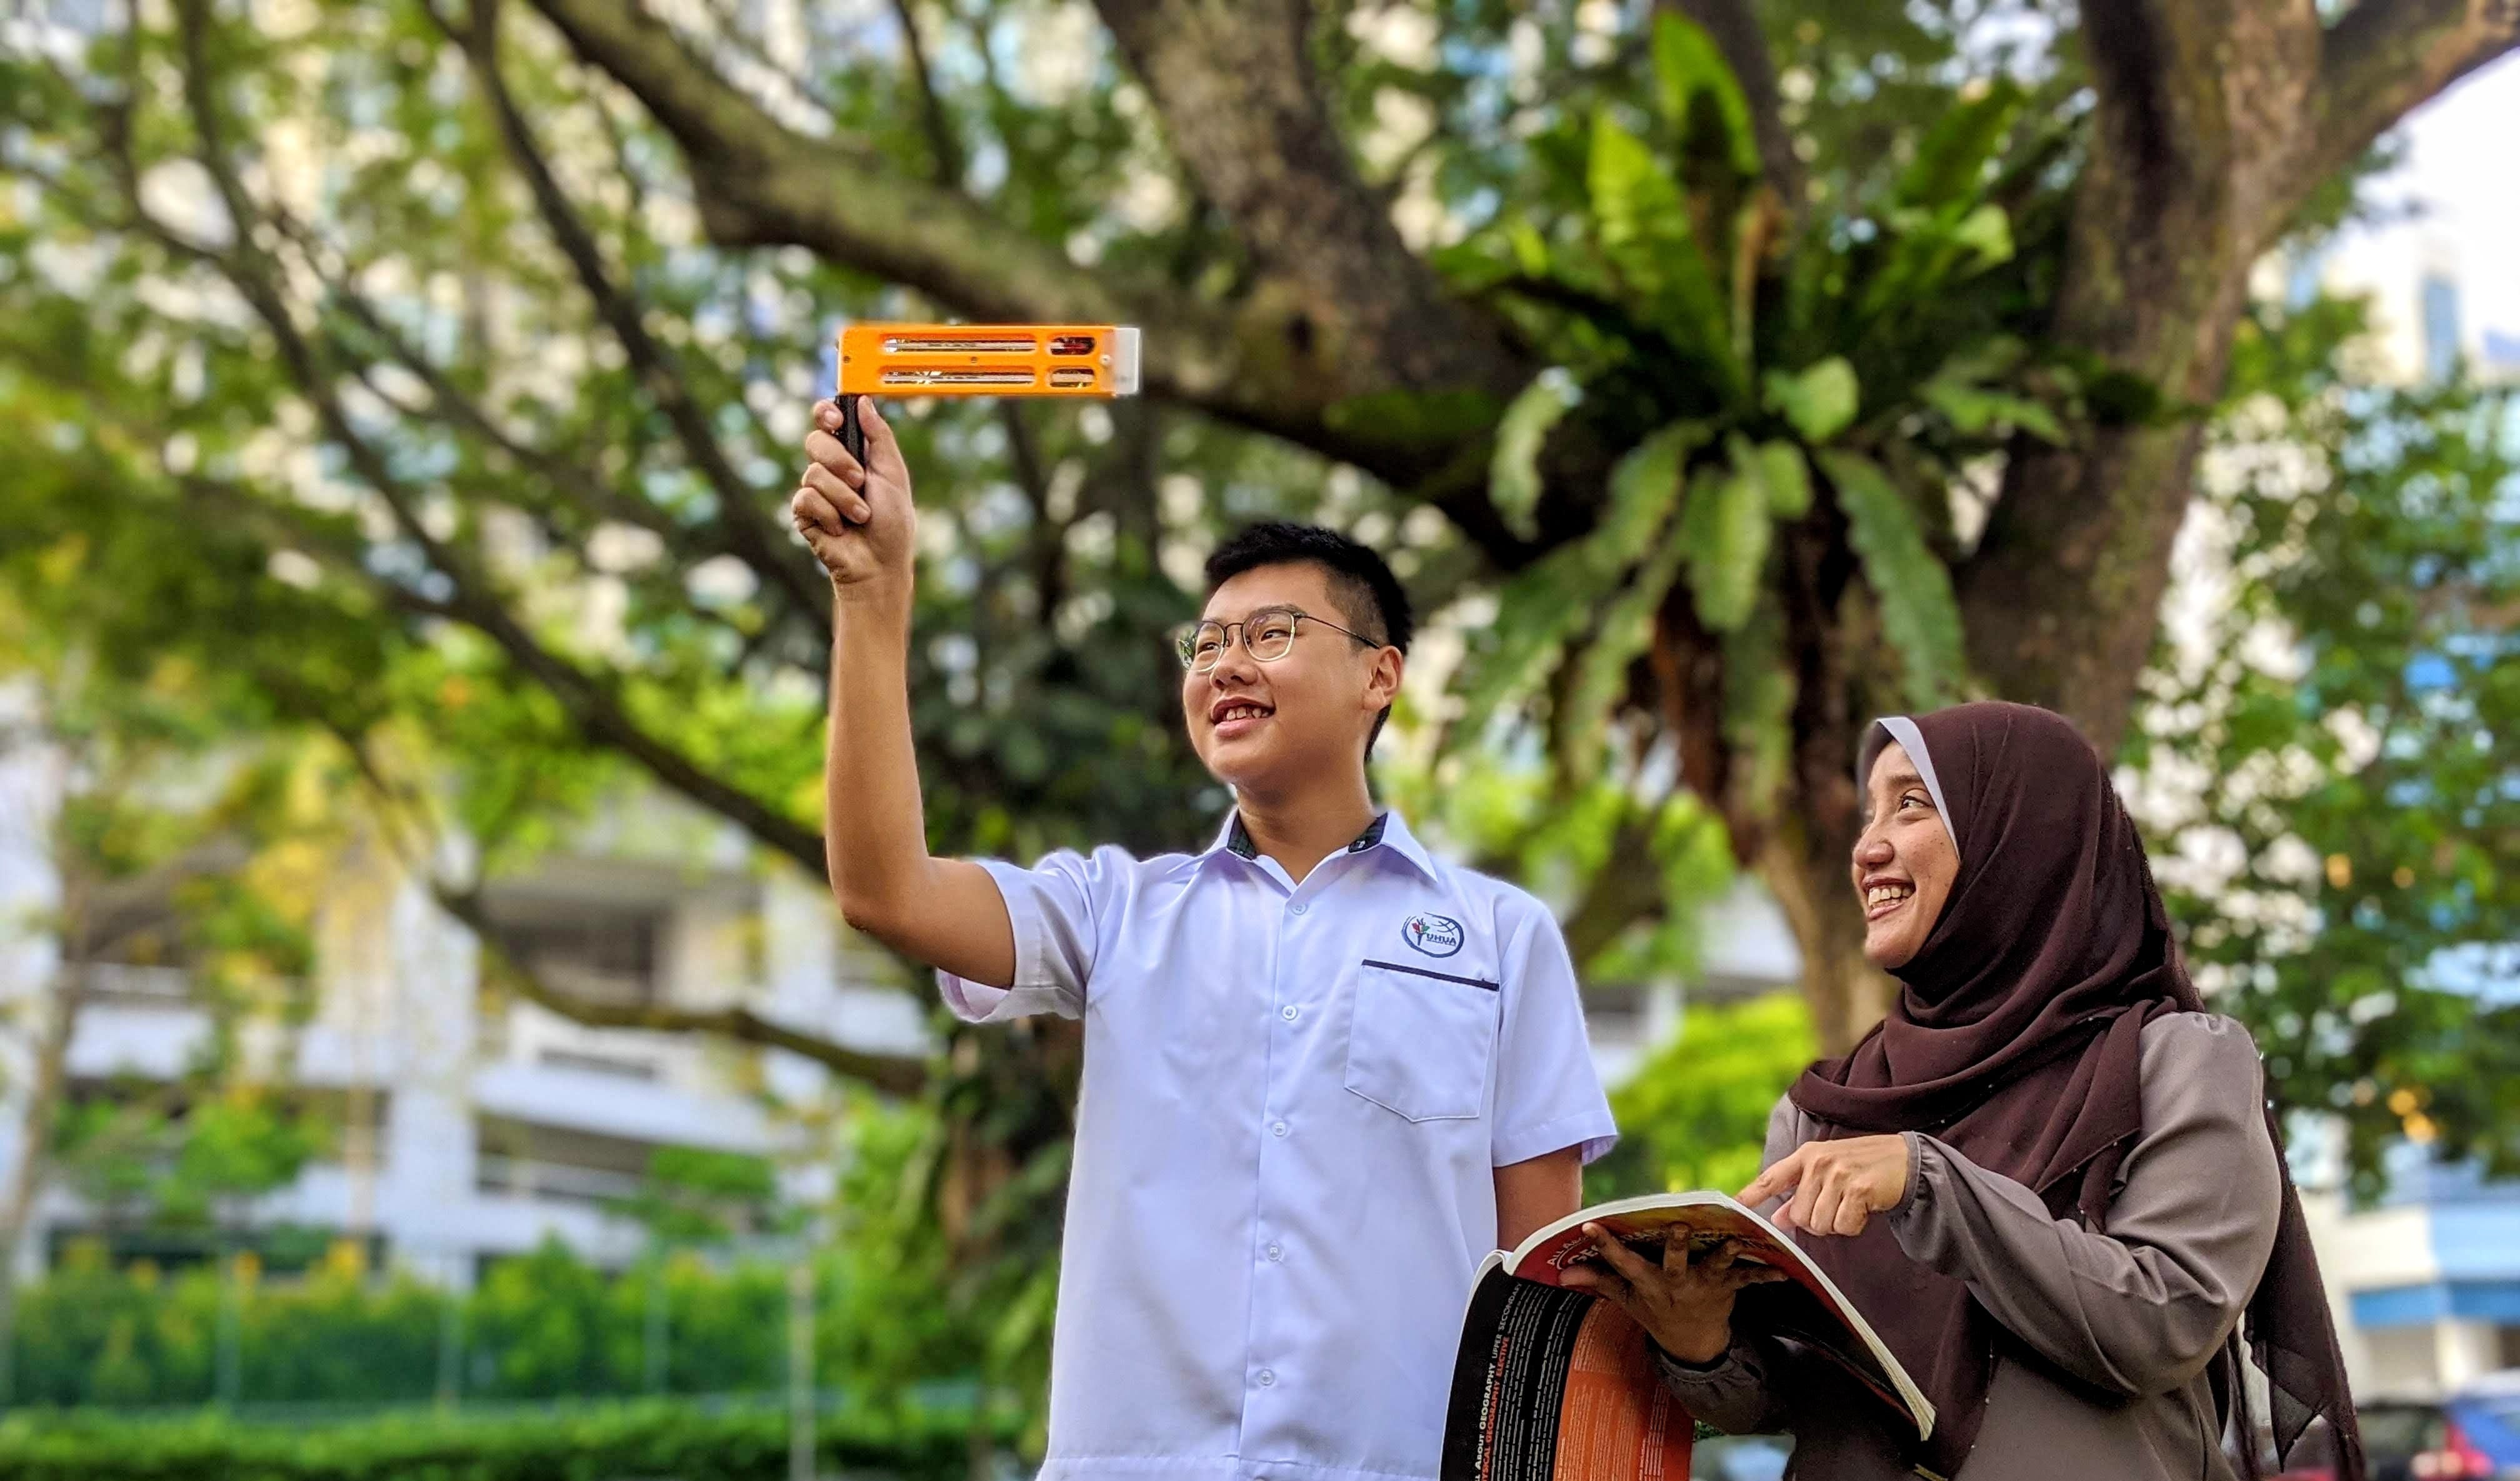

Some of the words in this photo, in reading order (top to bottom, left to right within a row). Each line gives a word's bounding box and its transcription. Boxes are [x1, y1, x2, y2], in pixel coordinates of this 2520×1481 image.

[1498, 1282, 1522, 1331] SECONDARY
[1491, 1334, 1503, 1359] UPPER
[1479, 1362, 1496, 1430] GEOGRAPHY
[1485, 1380, 1501, 1444] GEOGRAPHY
[1496, 1335, 1511, 1377] ELECTIVE
[1474, 1433, 1486, 1470] ABOUT
